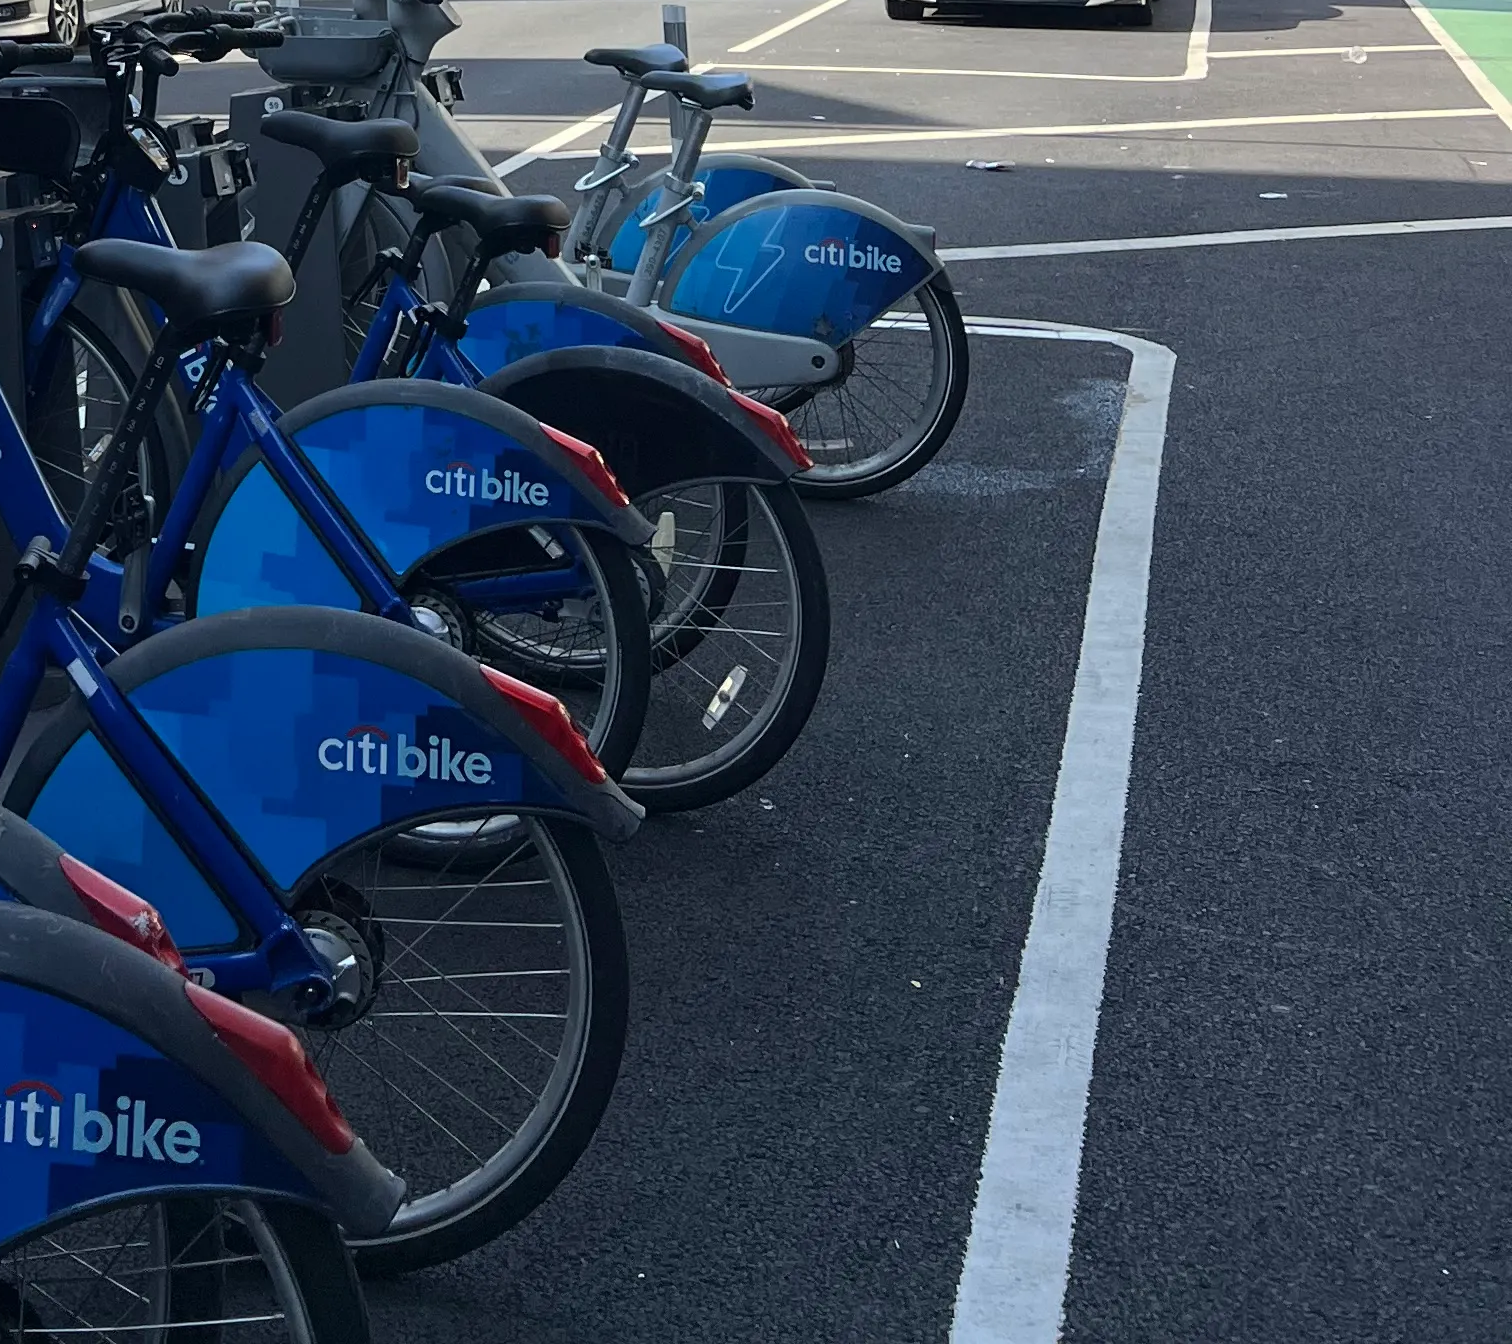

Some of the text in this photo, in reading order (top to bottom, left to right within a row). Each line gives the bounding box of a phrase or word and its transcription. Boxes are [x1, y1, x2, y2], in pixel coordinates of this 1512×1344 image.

[804, 242, 902, 273] citi bike
[425, 467, 550, 506] citi bike
[318, 733, 492, 784] citi bike
[72, 1093, 201, 1164] bike
